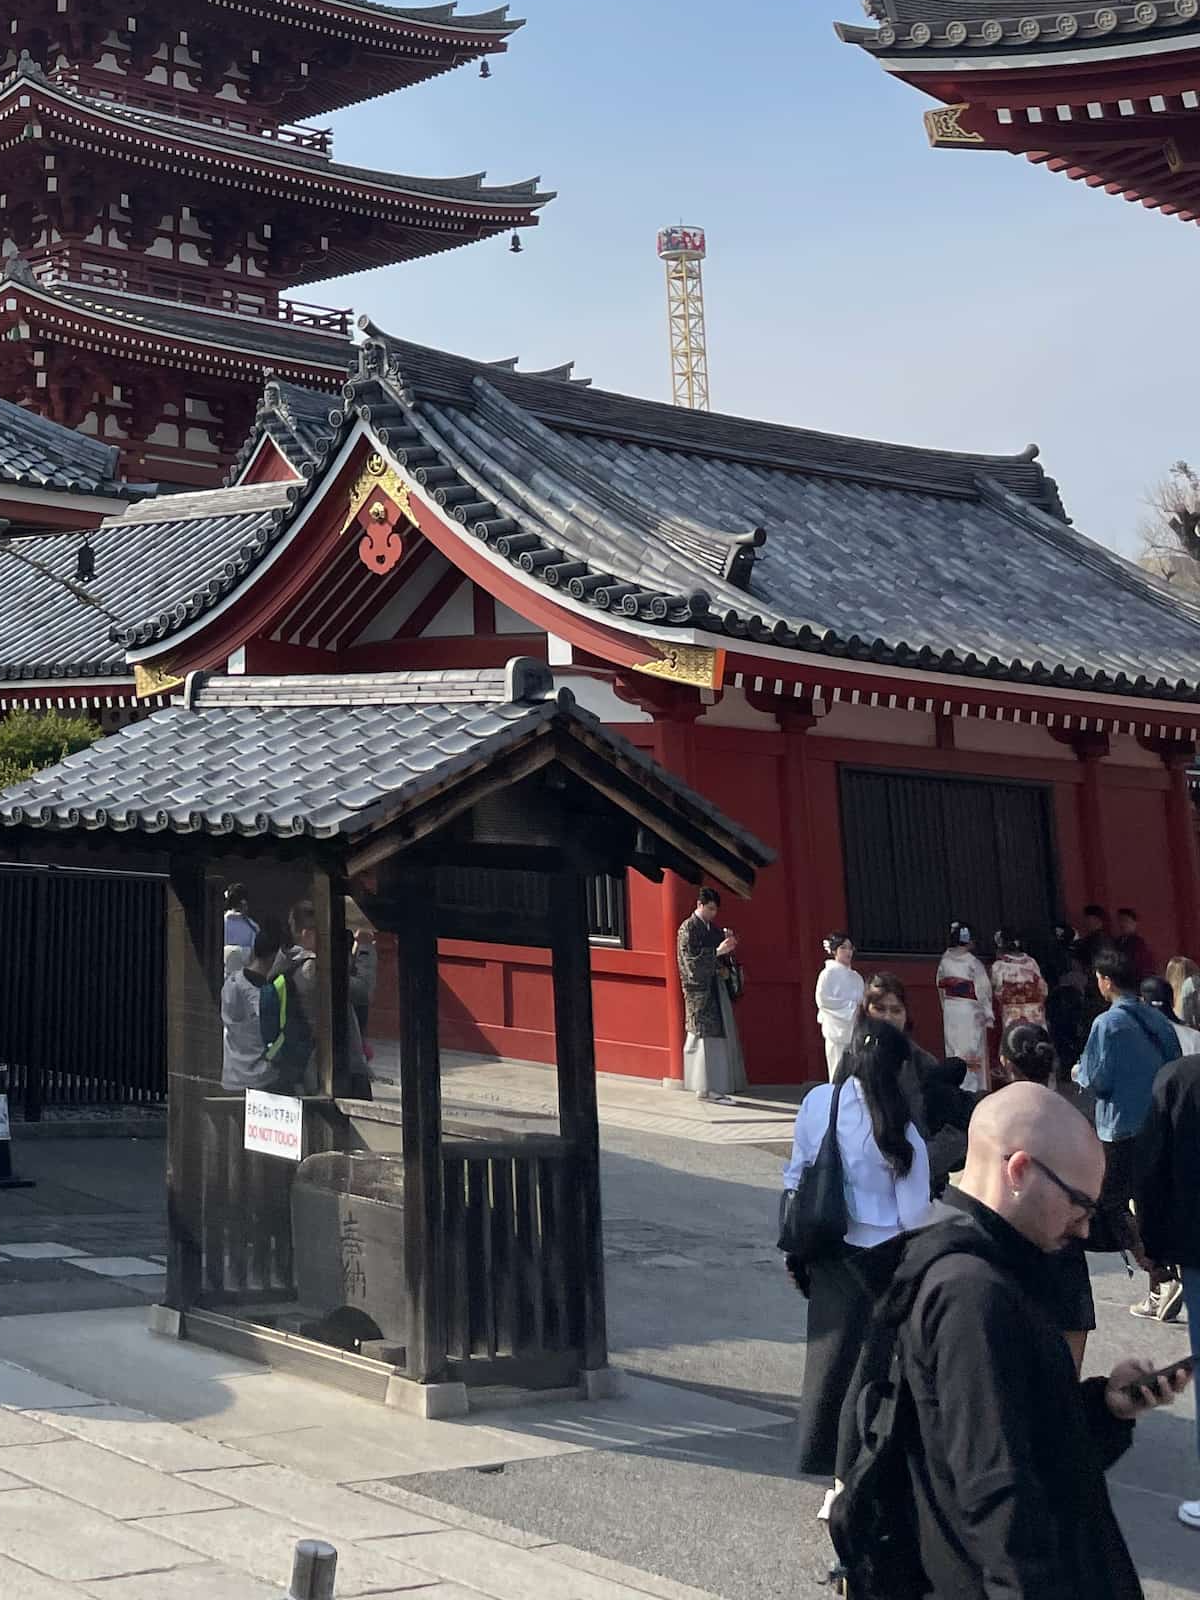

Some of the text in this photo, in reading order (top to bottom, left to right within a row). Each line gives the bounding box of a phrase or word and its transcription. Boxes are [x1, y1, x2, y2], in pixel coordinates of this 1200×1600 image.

[248, 1124, 298, 1147] DO NOT TOUCH
